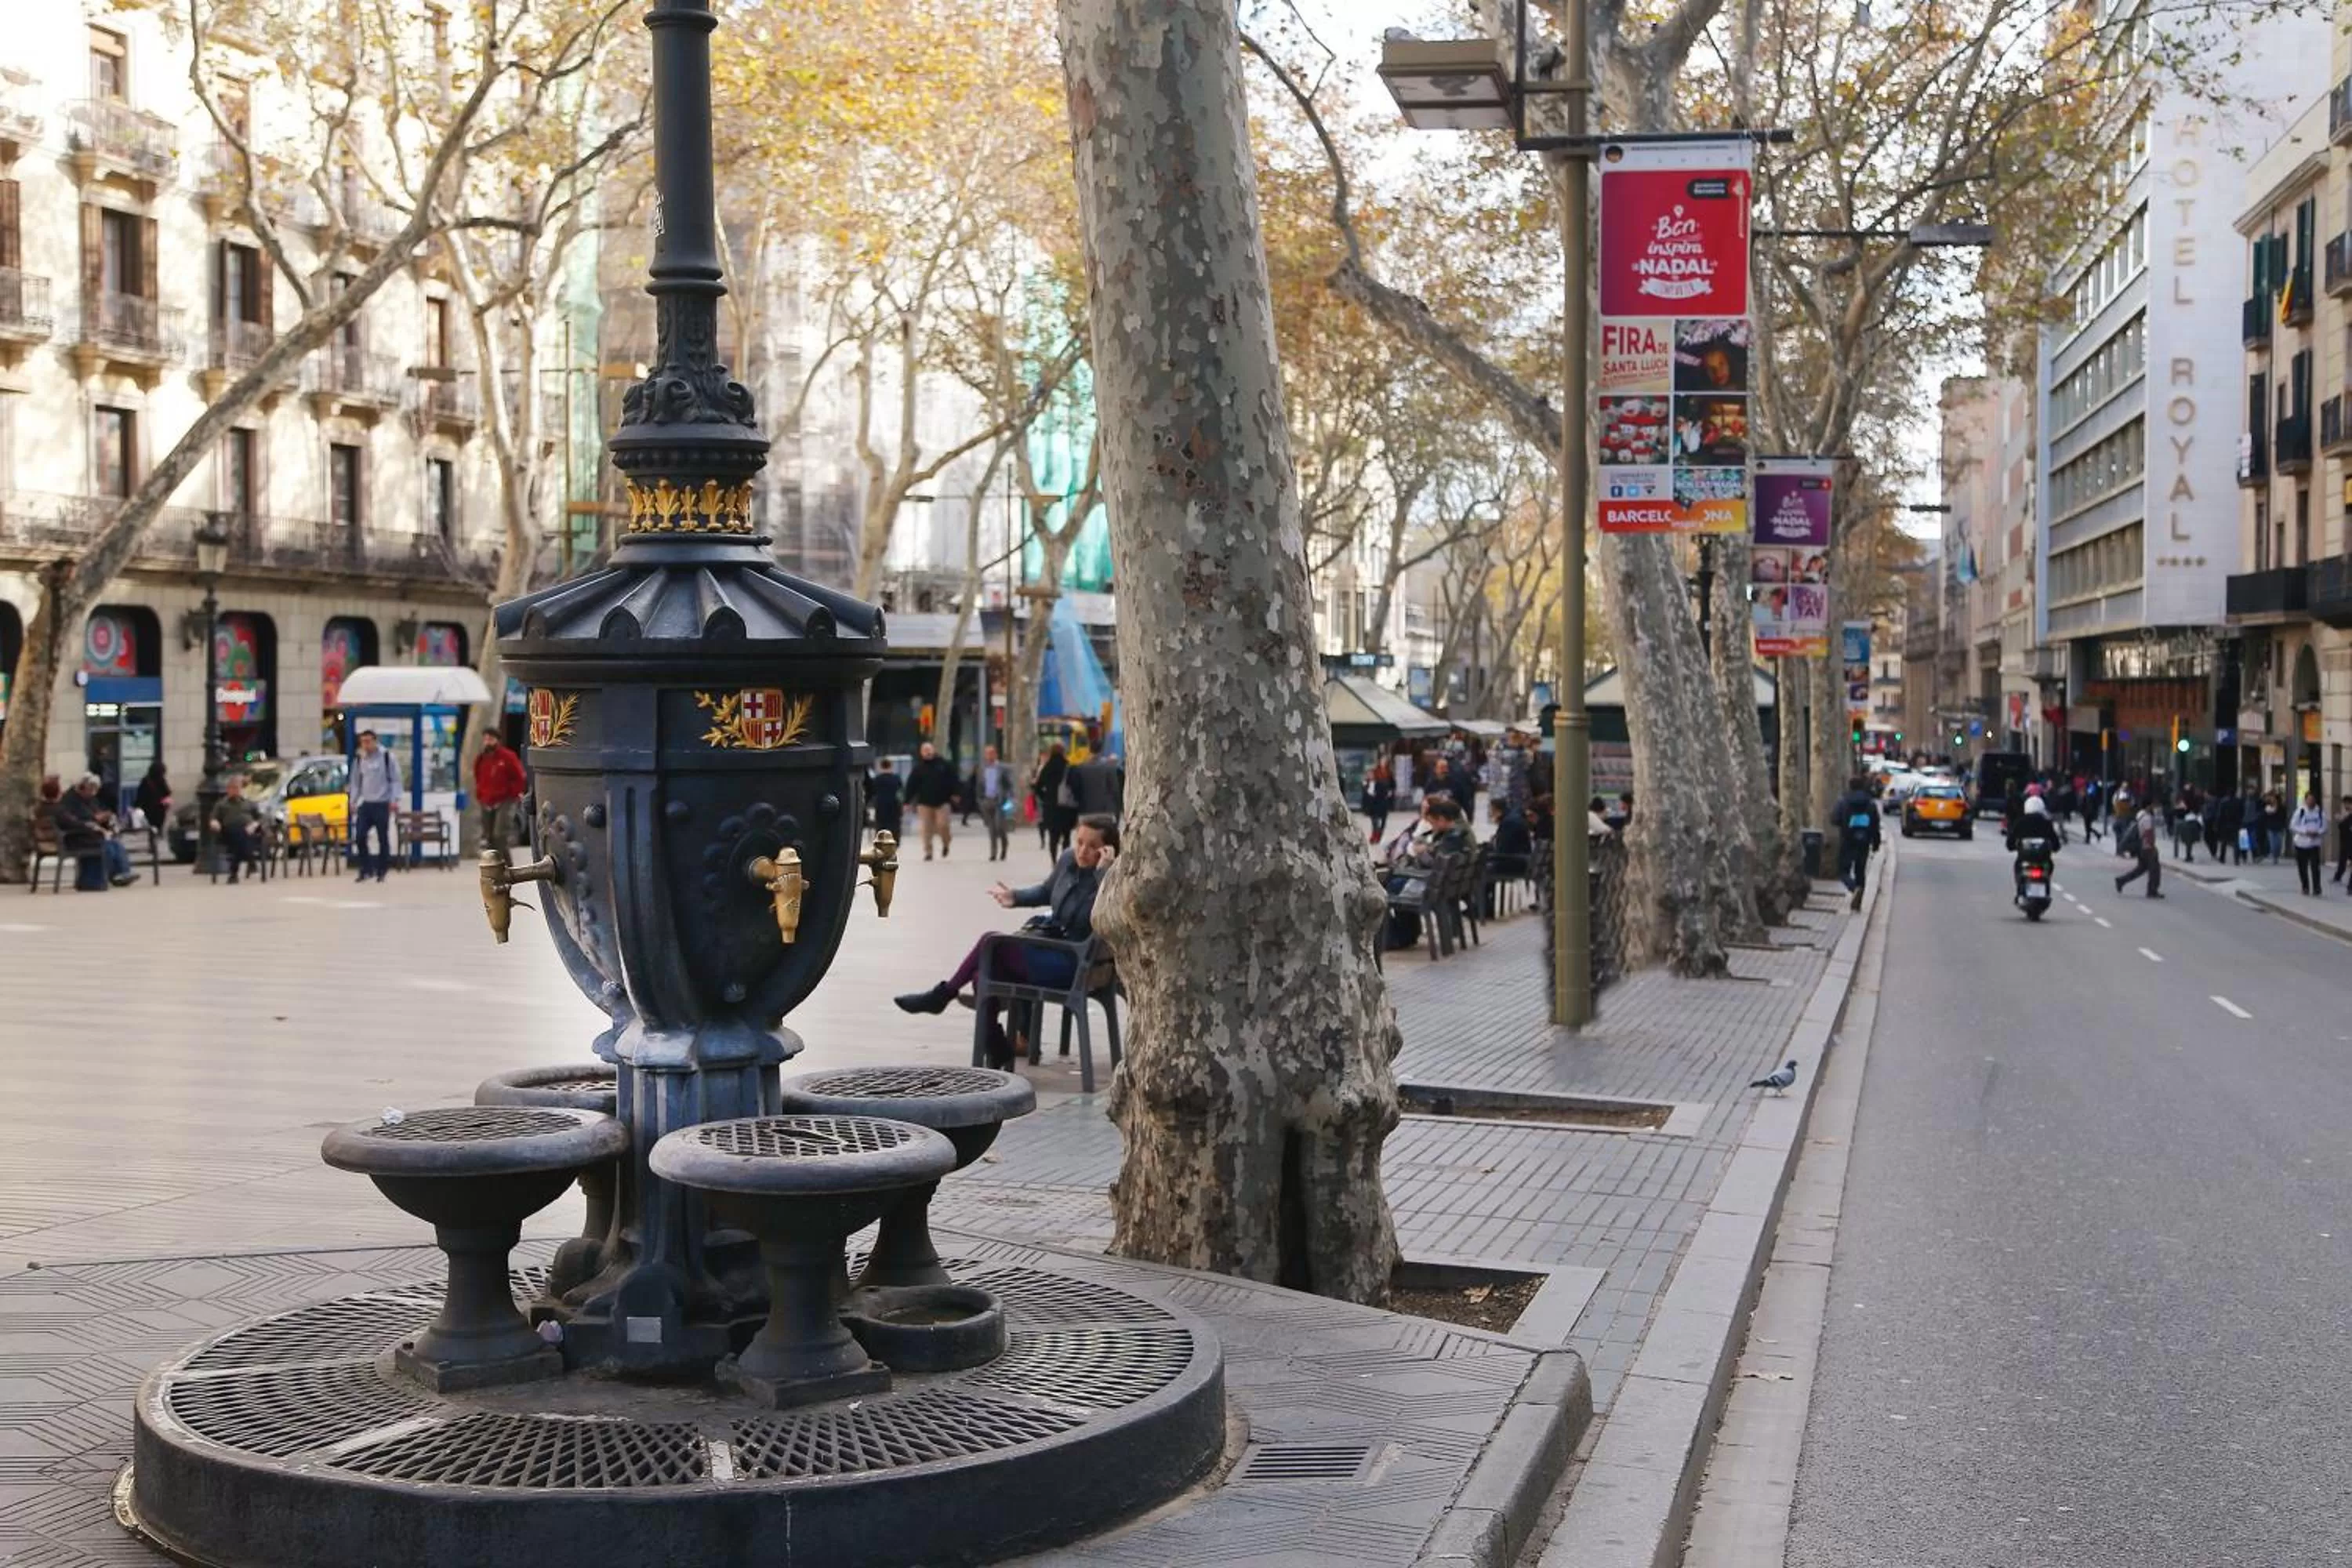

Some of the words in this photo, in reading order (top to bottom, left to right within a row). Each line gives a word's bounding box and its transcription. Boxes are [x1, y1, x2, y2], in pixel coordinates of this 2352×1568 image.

[2172, 114, 2199, 304] HOTEL
[1657, 216, 1696, 238] Bcn
[1647, 241, 1704, 256] inspira
[1639, 259, 1715, 274] NADAL
[1603, 325, 1656, 354] FIRA
[1603, 361, 1637, 374] SANTA
[2168, 358, 2195, 541] ROYAL
